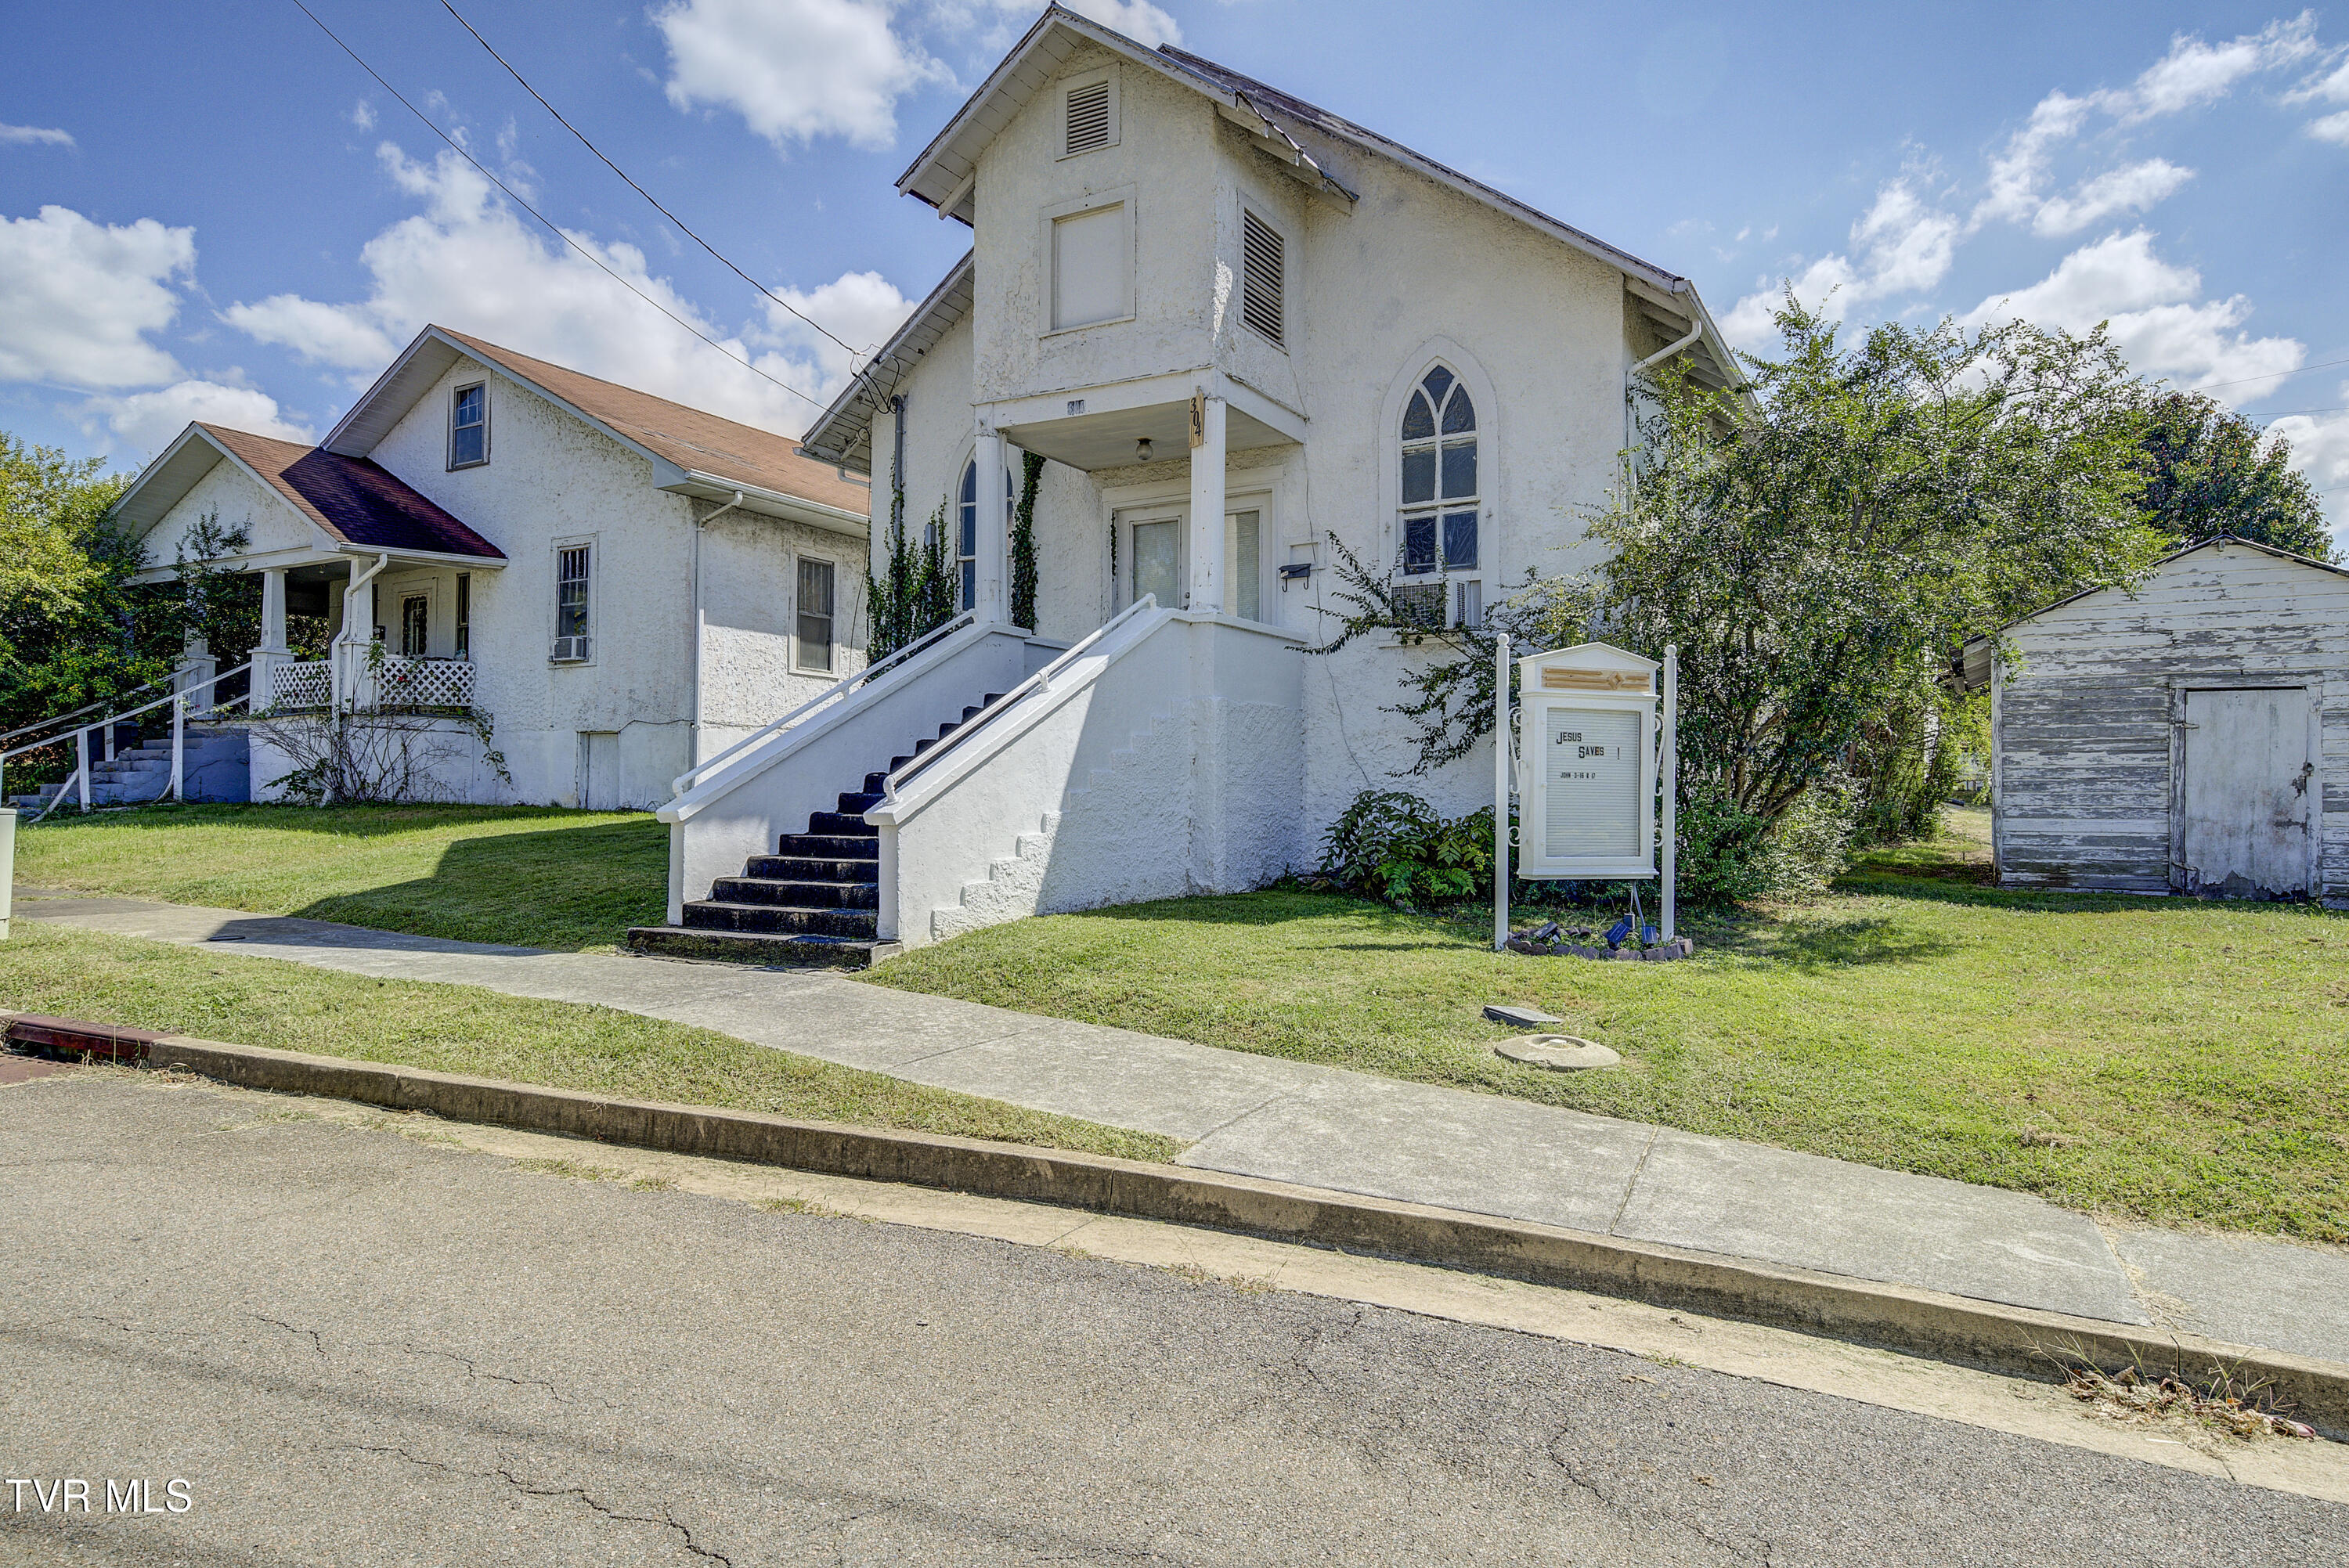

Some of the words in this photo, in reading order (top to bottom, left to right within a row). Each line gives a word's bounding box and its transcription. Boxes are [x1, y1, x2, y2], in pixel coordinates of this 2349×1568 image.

[1189, 396, 1202, 437] 304
[1556, 732, 1582, 744] JESUS
[1579, 746, 1604, 759] SAVES
